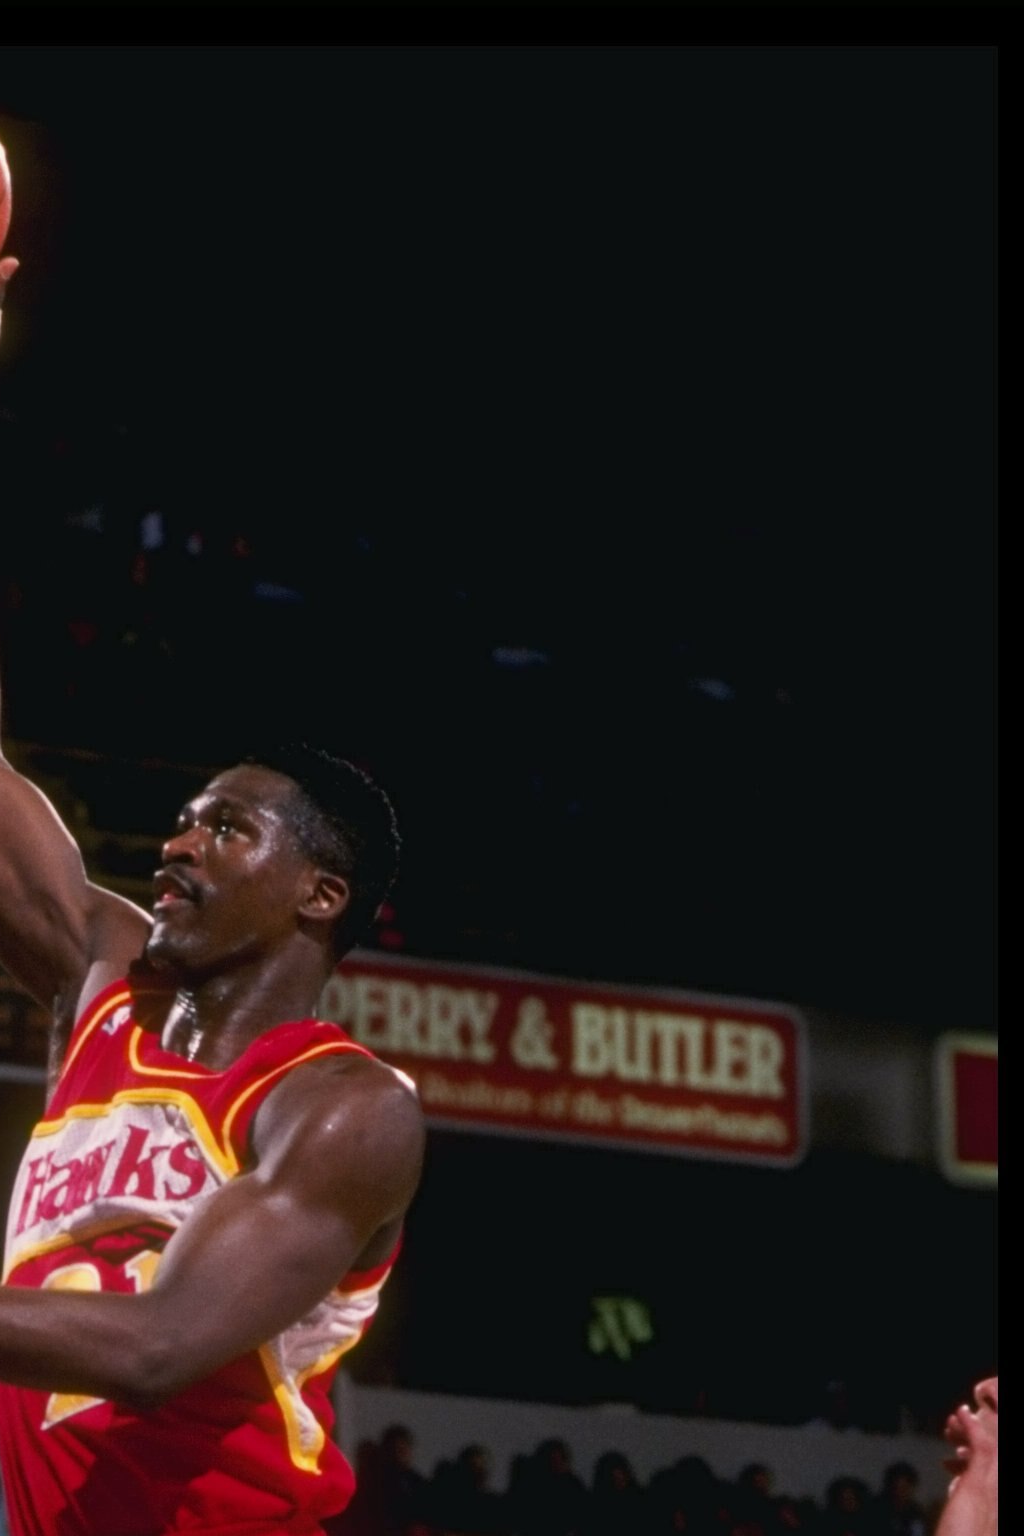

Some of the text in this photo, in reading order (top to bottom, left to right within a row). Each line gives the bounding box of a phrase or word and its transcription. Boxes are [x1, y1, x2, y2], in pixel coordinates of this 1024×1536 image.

[319, 974, 786, 1100] PERRY & BUTLER
[15, 1124, 208, 1237] Hawks
